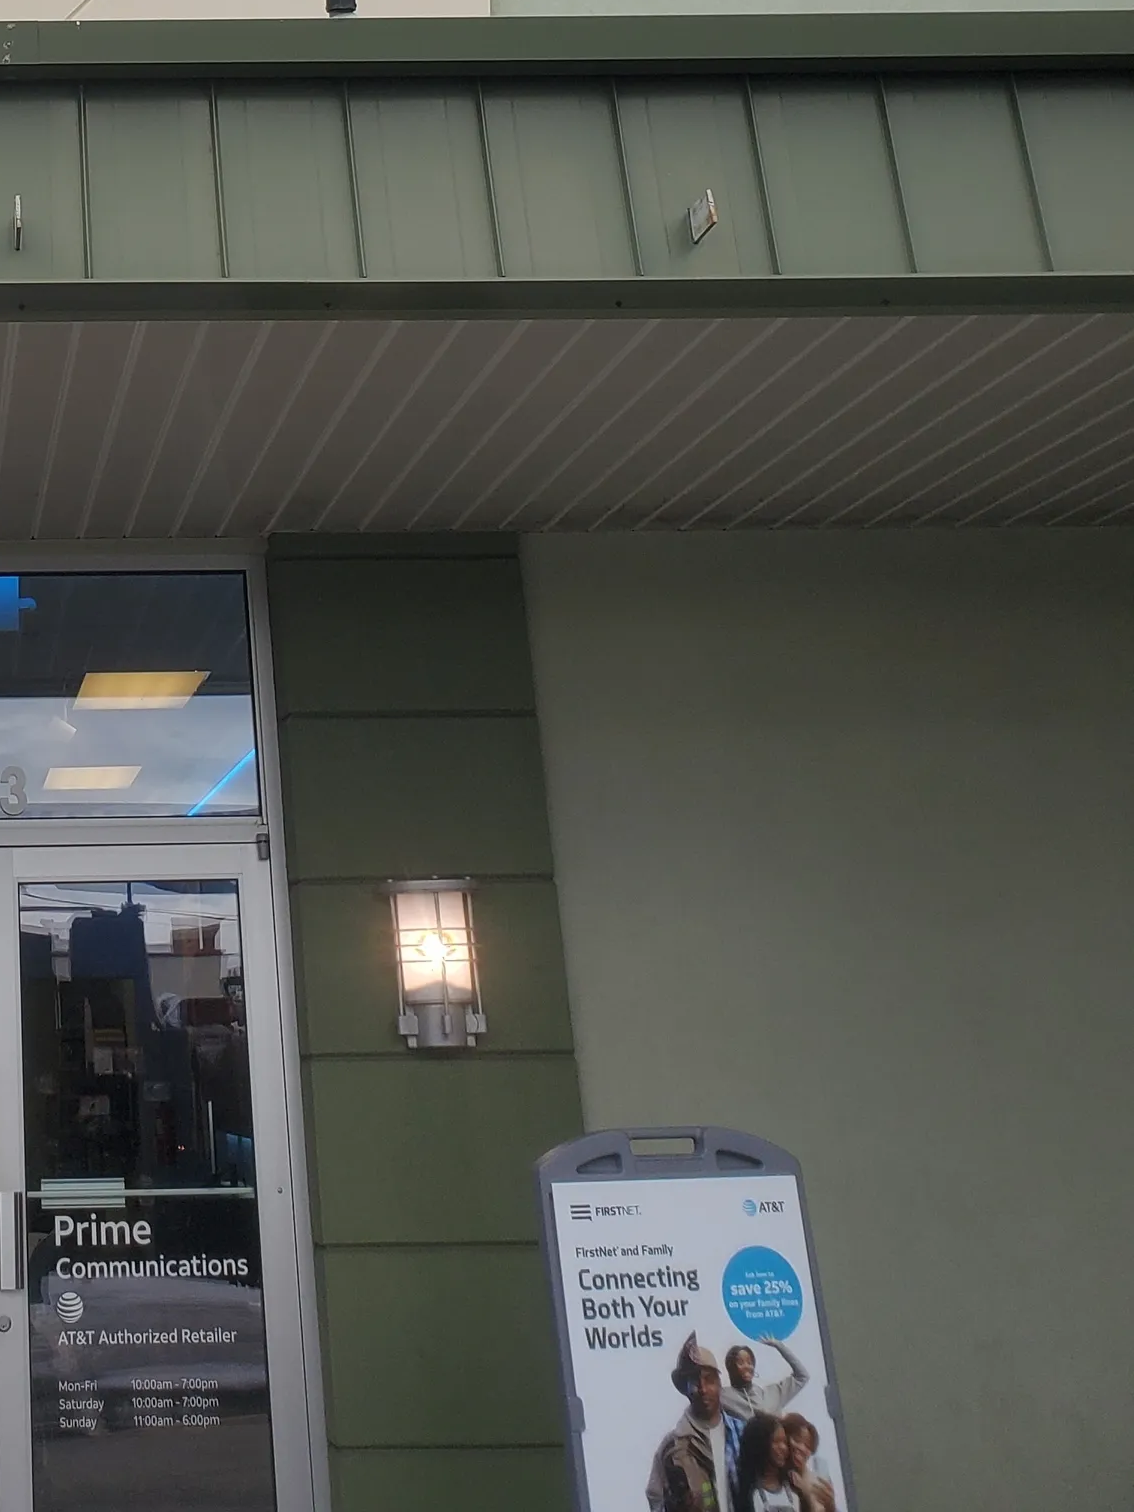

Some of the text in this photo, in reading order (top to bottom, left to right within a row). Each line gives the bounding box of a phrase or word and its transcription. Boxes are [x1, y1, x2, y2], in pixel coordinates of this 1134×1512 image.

[759, 1201, 785, 1213] AT&T
[54, 1213, 152, 1246] Prime
[621, 1245, 639, 1256] and
[641, 1244, 673, 1257] Family
[56, 1254, 249, 1280] Communications
[578, 1265, 700, 1291] Connecting
[730, 1280, 793, 1296] save 25%
[581, 1295, 689, 1320] Both Your
[746, 1309, 764, 1319] from
[58, 1327, 237, 1346] AT&T Authorized Retailer
[584, 1324, 663, 1349] Worlds
[58, 1380, 98, 1392] Mon-Fri
[131, 1379, 173, 1391] 10:00am
[181, 1378, 218, 1392] 7:00pm
[59, 1398, 105, 1412] Saturday
[132, 1397, 174, 1409] 10:00am
[182, 1396, 219, 1410] 7:00pm
[59, 1416, 98, 1431] Sunday
[182, 1414, 220, 1429] 6:00pm
